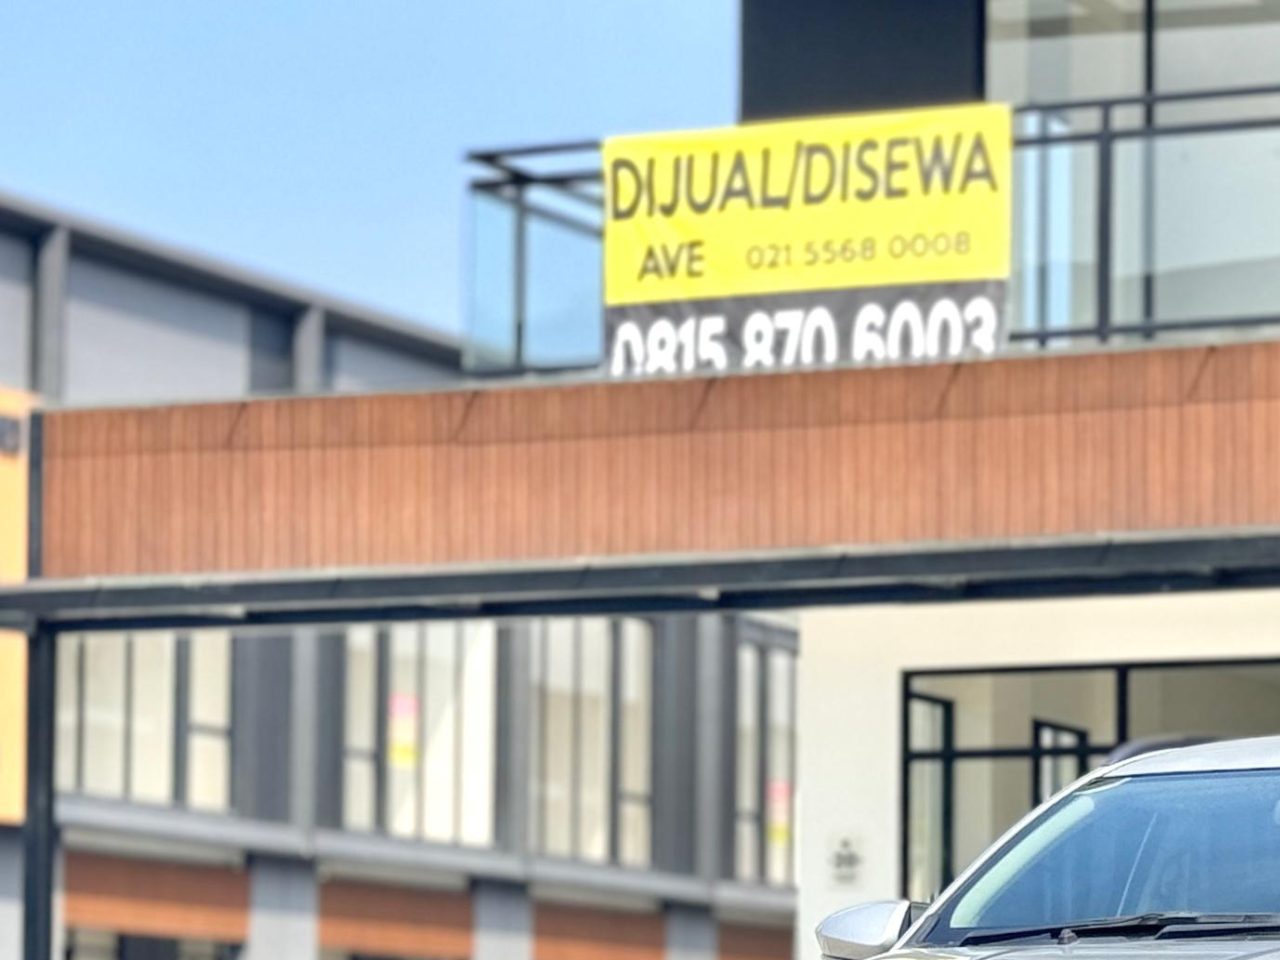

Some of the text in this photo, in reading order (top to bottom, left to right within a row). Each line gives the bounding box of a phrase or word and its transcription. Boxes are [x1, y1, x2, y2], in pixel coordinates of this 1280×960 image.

[611, 132, 998, 220] DIJUAL/DISEWA
[638, 232, 971, 281] AVE 021 5568 0008
